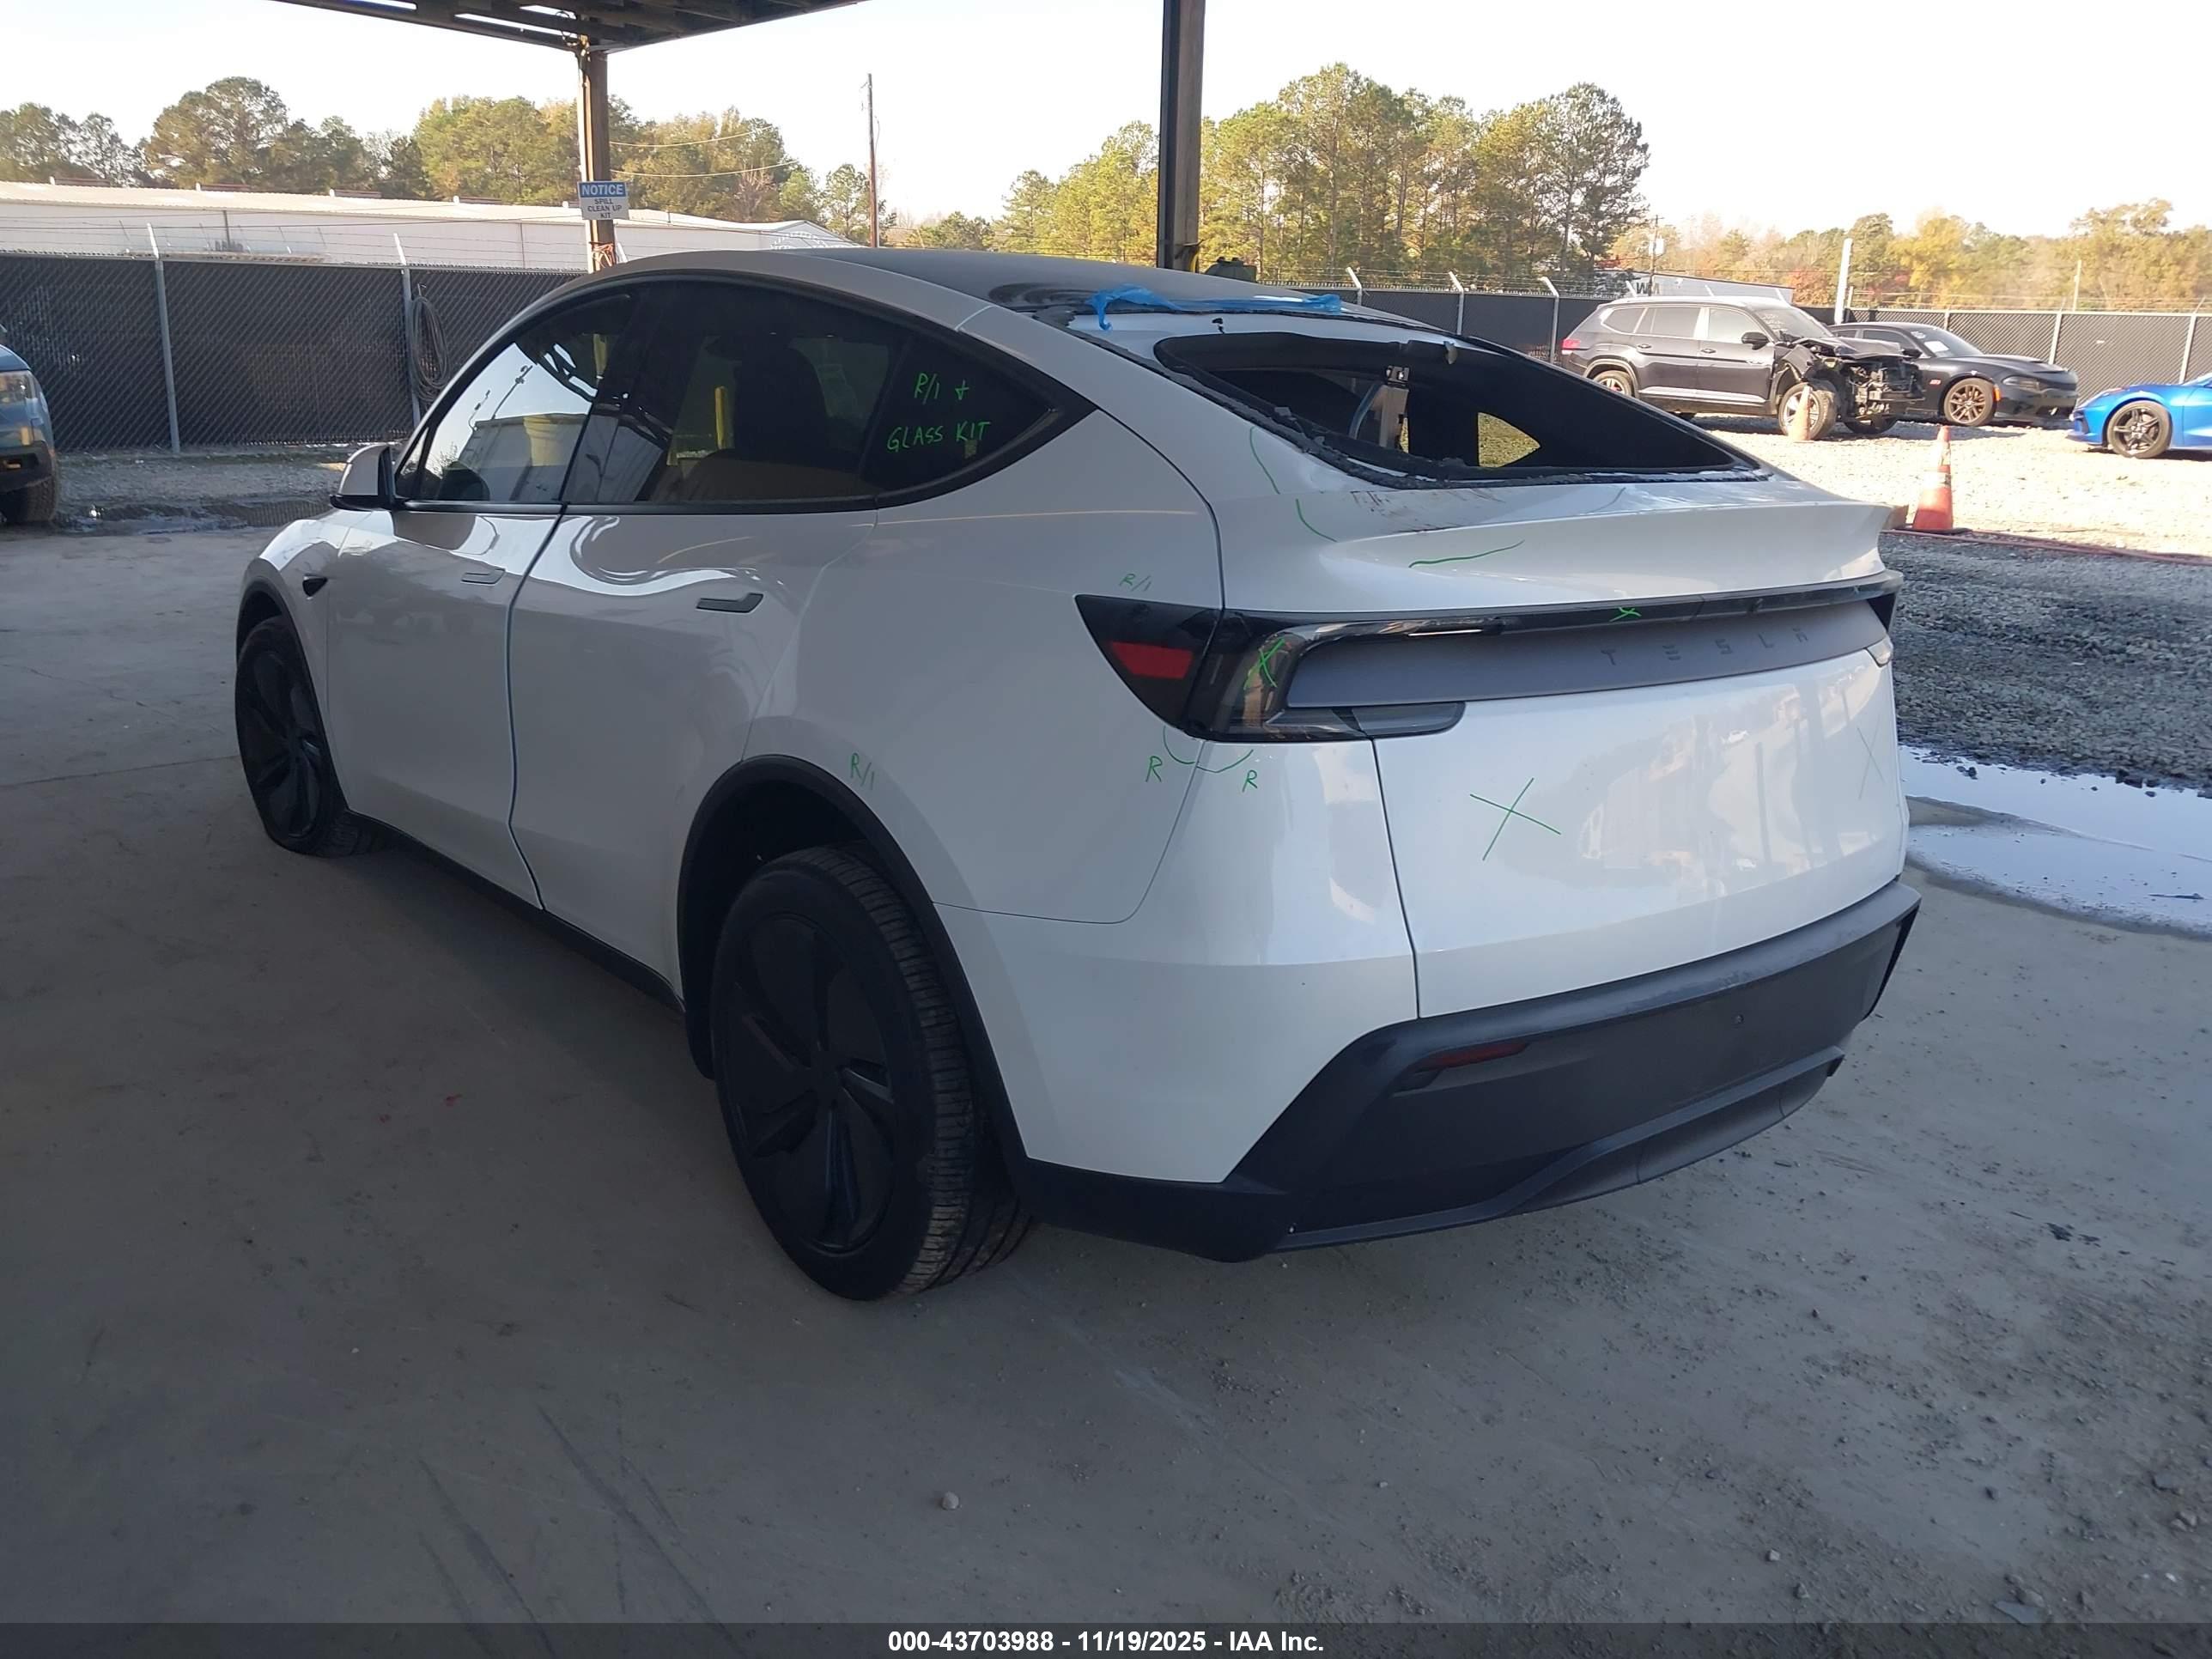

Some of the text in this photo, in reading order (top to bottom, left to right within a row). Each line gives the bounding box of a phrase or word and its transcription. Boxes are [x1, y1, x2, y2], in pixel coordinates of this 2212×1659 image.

[581, 184, 623, 196] NOTICE
[887, 421, 991, 453] GLASS KIT
[1600, 628, 1808, 666] TESLA
[1146, 755, 1164, 783] R
[1242, 769, 1259, 793] R
